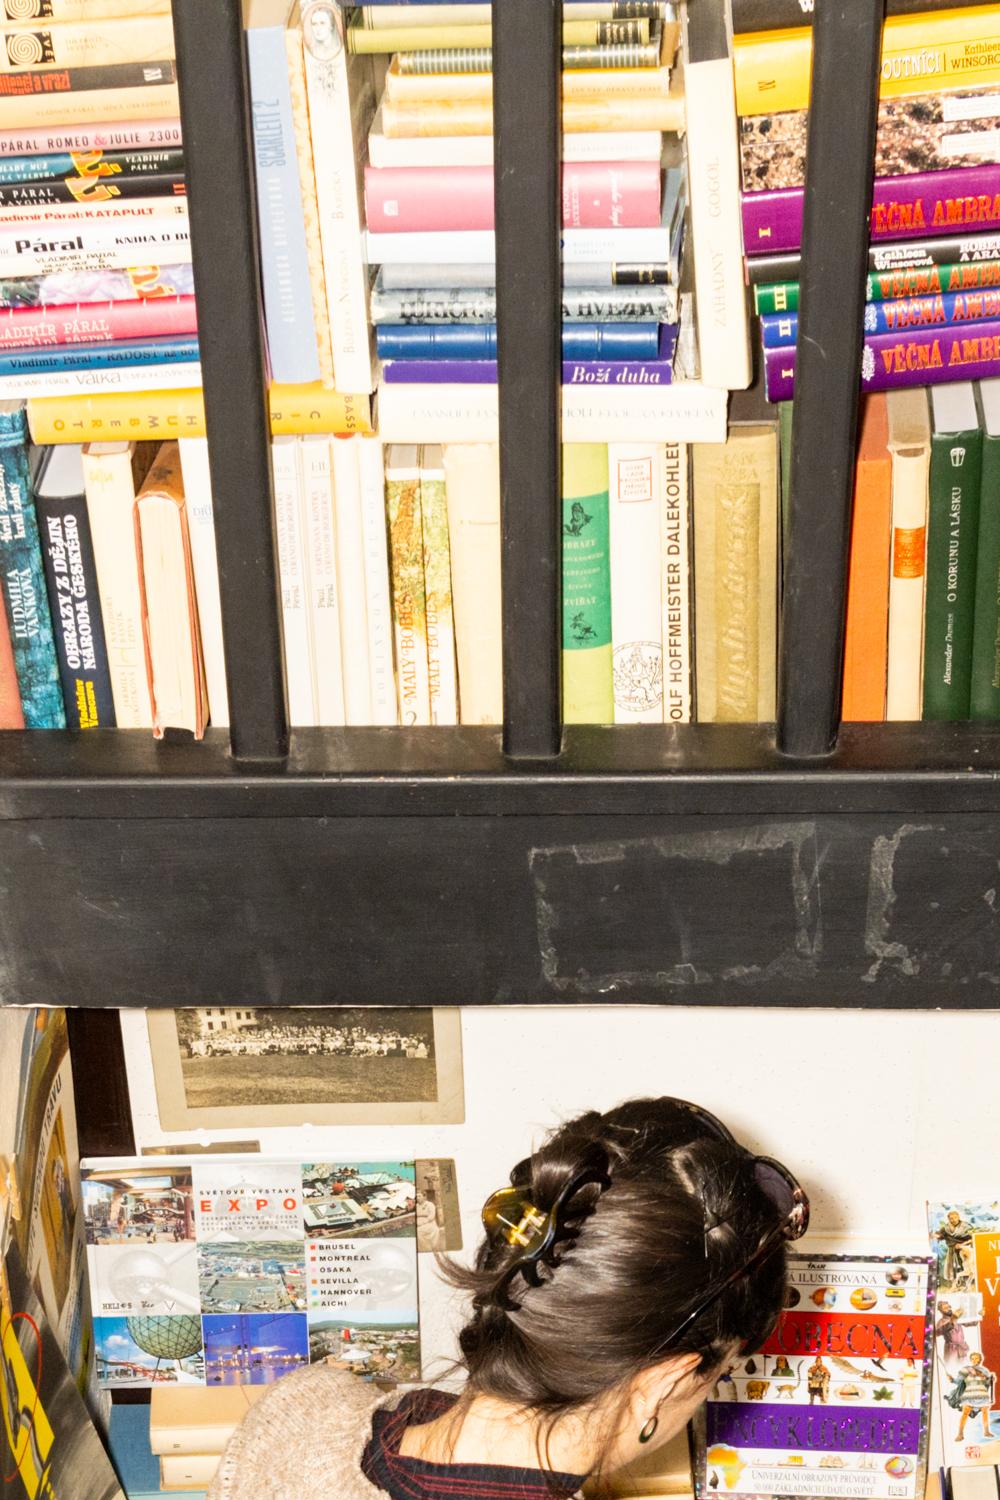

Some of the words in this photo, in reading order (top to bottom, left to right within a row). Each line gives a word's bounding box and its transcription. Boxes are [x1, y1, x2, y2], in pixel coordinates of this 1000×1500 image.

[1, 138, 40, 152] PÁRAL
[47, 135, 90, 149] ROMEO
[110, 130, 141, 145] JULIE
[149, 129, 180, 143] 2300
[256, 109, 287, 169] SCARLETT
[125, 153, 170, 164] VLADIMÍR
[12, 187, 55, 199] PÁRAL
[84, 206, 155, 219] KATAPULT
[873, 199, 926, 233] ĚČNÁ
[14, 235, 85, 254] Páral
[115, 232, 157, 245] KNIHA
[0, 322, 57, 339] LADIMÍR
[63, 320, 110, 335] PÁRAL
[881, 339, 943, 374] VĚČNÁ
[572, 366, 611, 384] Boží
[615, 366, 661, 384] duha
[951, 485, 963, 527] LÁSKU
[46, 514, 68, 575] DĚJIN
[948, 539, 960, 592] KORUNU
[6, 568, 29, 639] LUDMILA
[56, 588, 82, 670] OBRAZY
[667, 562, 683, 683] HOFFMEISTER
[71, 602, 98, 670] NÁRODA
[671, 691, 684, 723] OLF
[200, 1197, 298, 1213] EXPO
[318, 1243, 356, 1251] BRUSEL
[318, 1254, 372, 1263] MONTREAL
[319, 1277, 360, 1285] SEVILLA
[798, 1272, 878, 1286] ILUSTROVANÁ
[984, 1277, 1000, 1297] V
[320, 1288, 373, 1296] HANNOVER
[777, 1317, 920, 1356] OBECNÁ
